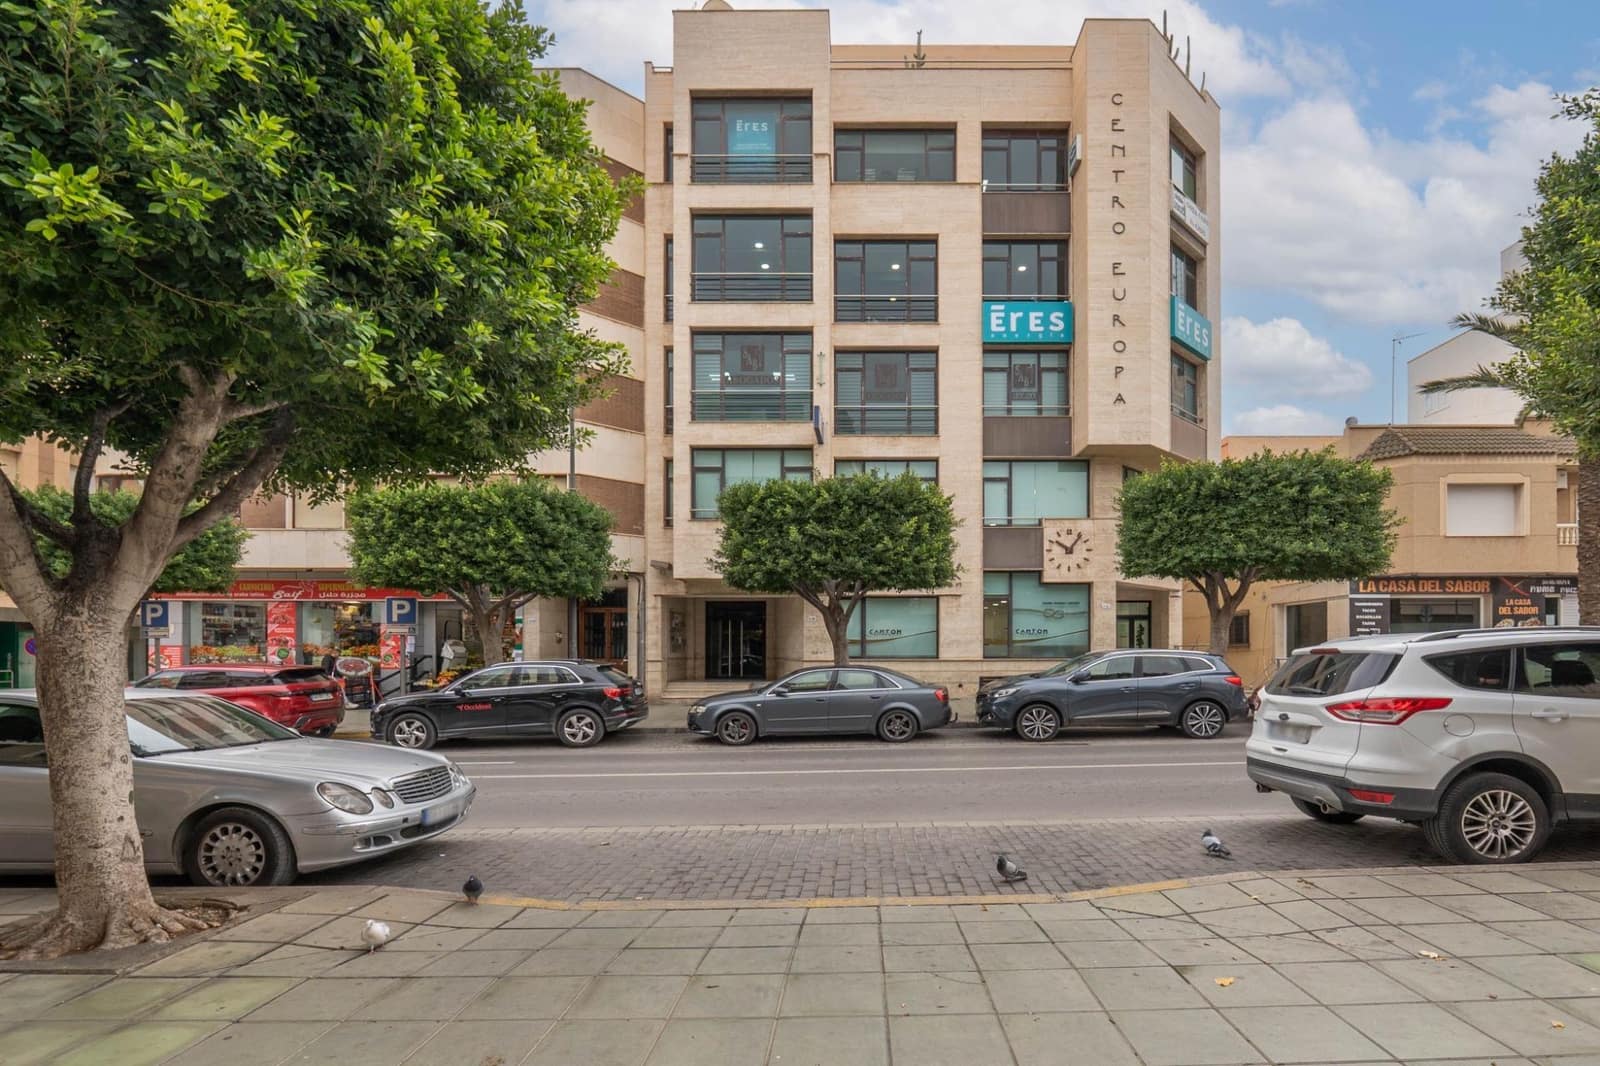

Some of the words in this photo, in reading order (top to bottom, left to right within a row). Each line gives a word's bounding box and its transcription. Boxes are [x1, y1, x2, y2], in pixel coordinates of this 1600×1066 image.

[1111, 93, 1126, 235] CENTRO
[1112, 262, 1127, 404] EUROPA
[1359, 580, 1377, 593] LA
[1380, 580, 1417, 593] CASA
[1420, 580, 1443, 593] DEL
[1445, 580, 1490, 593] SABOR
[145, 604, 163, 625] P
[391, 600, 411, 622] P
[1498, 606, 1513, 615] DEL
[1513, 606, 1539, 615] SABOR
